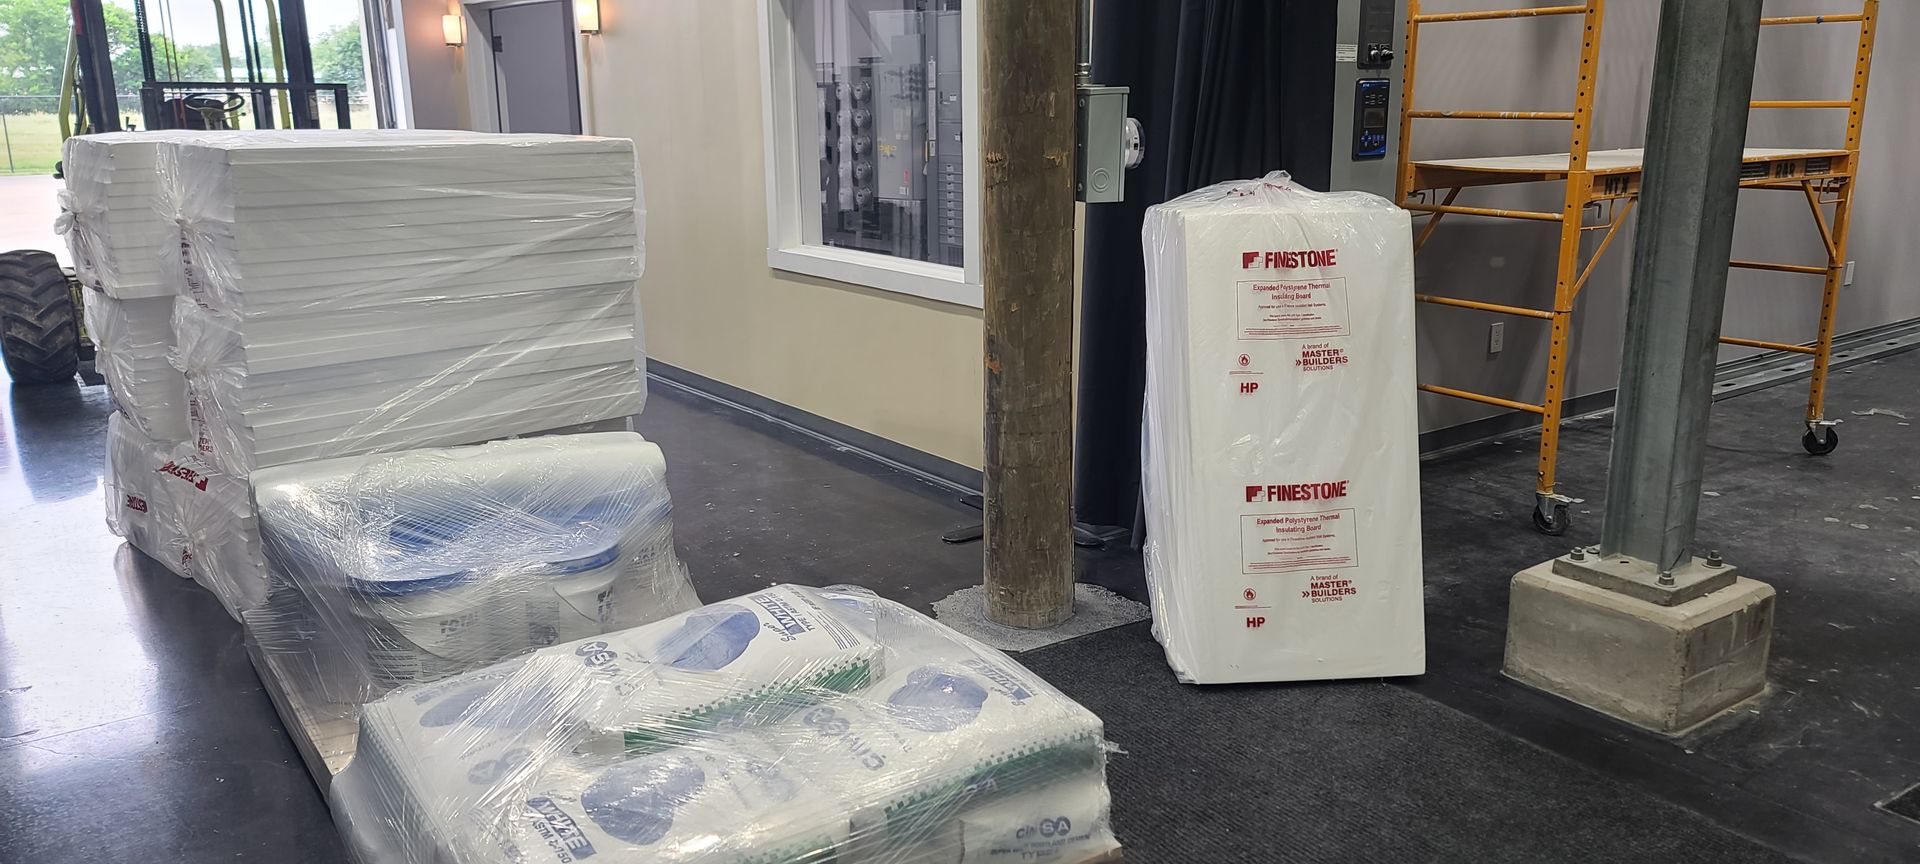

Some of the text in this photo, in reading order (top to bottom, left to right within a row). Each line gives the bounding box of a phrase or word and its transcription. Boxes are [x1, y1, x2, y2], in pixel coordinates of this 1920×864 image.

[1265, 249, 1337, 269] FINESTONE
[1253, 283, 1280, 292] Expanded
[1308, 282, 1331, 290] Thermal
[1295, 292, 1311, 300] Board
[1302, 356, 1348, 366] BUILDERS
[1240, 382, 1259, 393] HP
[1267, 480, 1347, 502] FINESTONE
[1256, 513, 1340, 526] Expanded Polystyrene Thermal
[1276, 524, 1321, 533] Insulating Board
[1311, 587, 1357, 597] BUILDERS
[1246, 617, 1266, 628] HP
